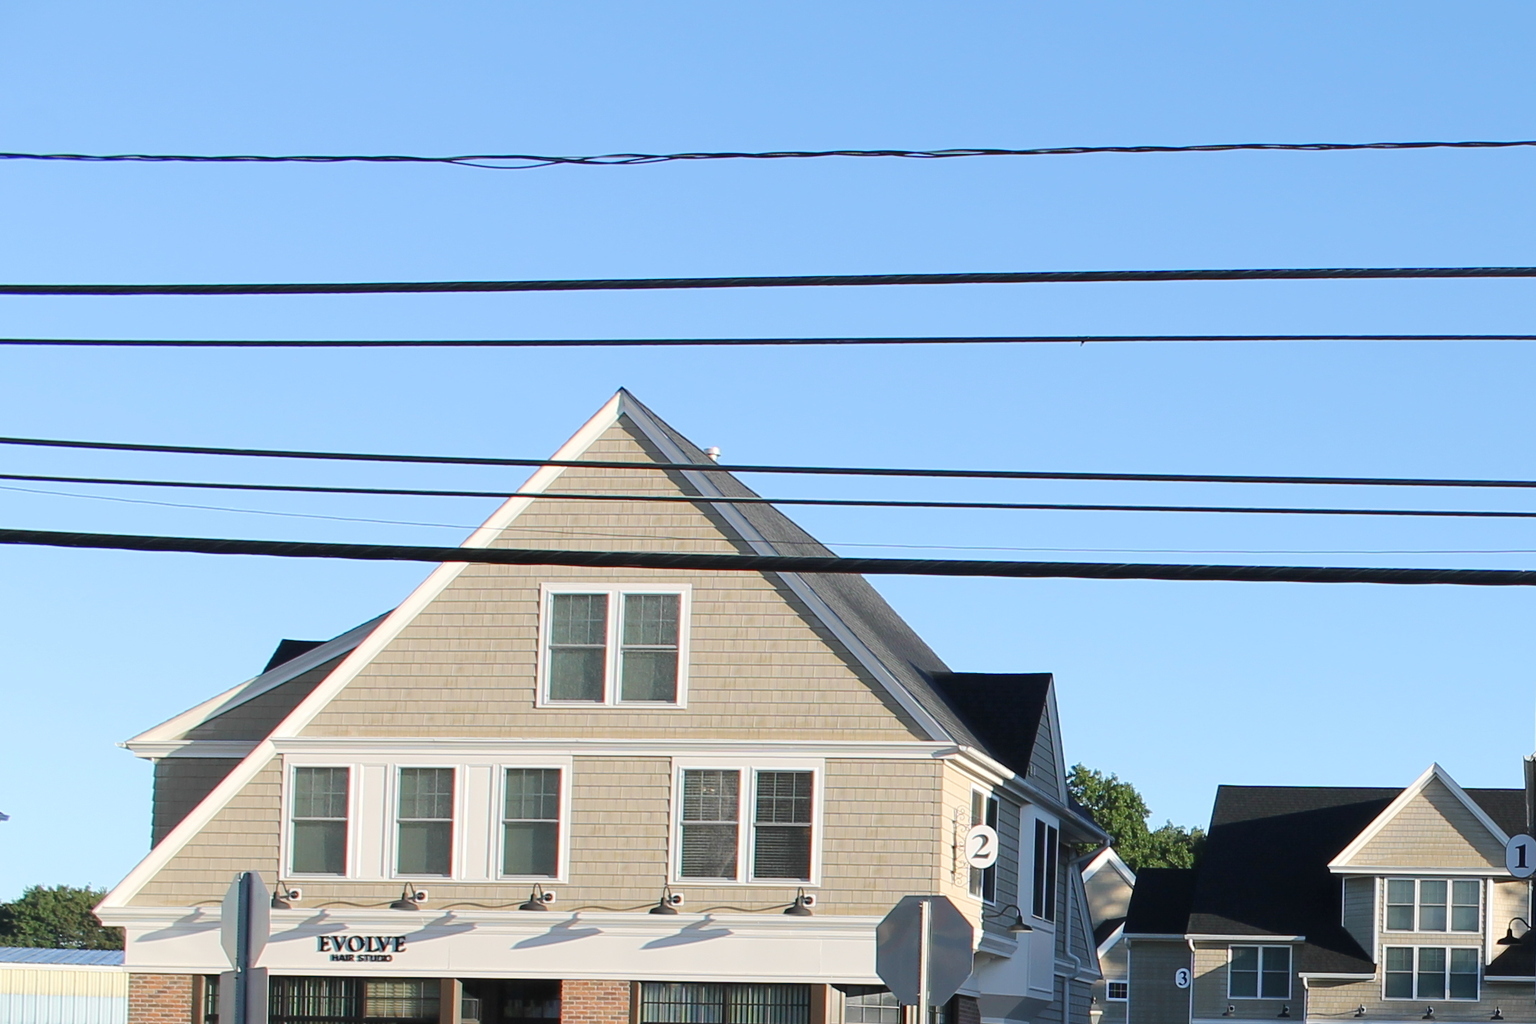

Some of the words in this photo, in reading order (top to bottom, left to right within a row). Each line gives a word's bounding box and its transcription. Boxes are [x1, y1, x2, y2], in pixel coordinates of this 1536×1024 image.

[971, 834, 991, 859] 2
[1515, 844, 1529, 868] 1
[317, 936, 406, 952] EVOLVE
[1179, 971, 1188, 986] 3
